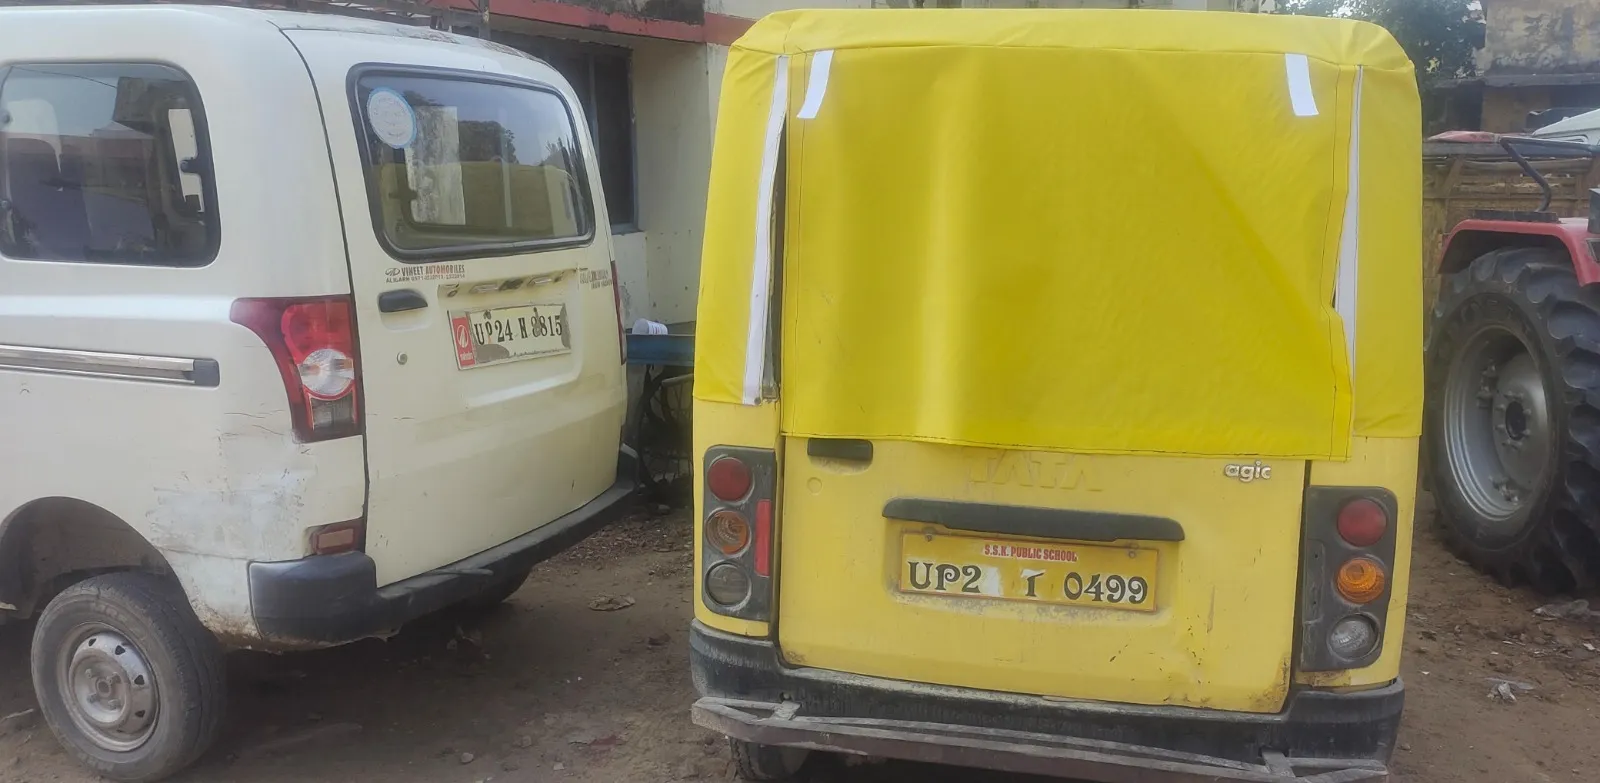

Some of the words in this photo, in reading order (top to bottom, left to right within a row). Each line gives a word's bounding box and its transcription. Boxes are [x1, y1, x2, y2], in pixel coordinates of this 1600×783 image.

[401, 266, 424, 277] VINEET
[425, 264, 465, 275] AUTOMOBILES
[1224, 460, 1271, 483] agic
[1010, 546, 1042, 560] PUBLIC
[1043, 549, 1078, 562] SCHOOL
[1064, 571, 1148, 605] 0499
